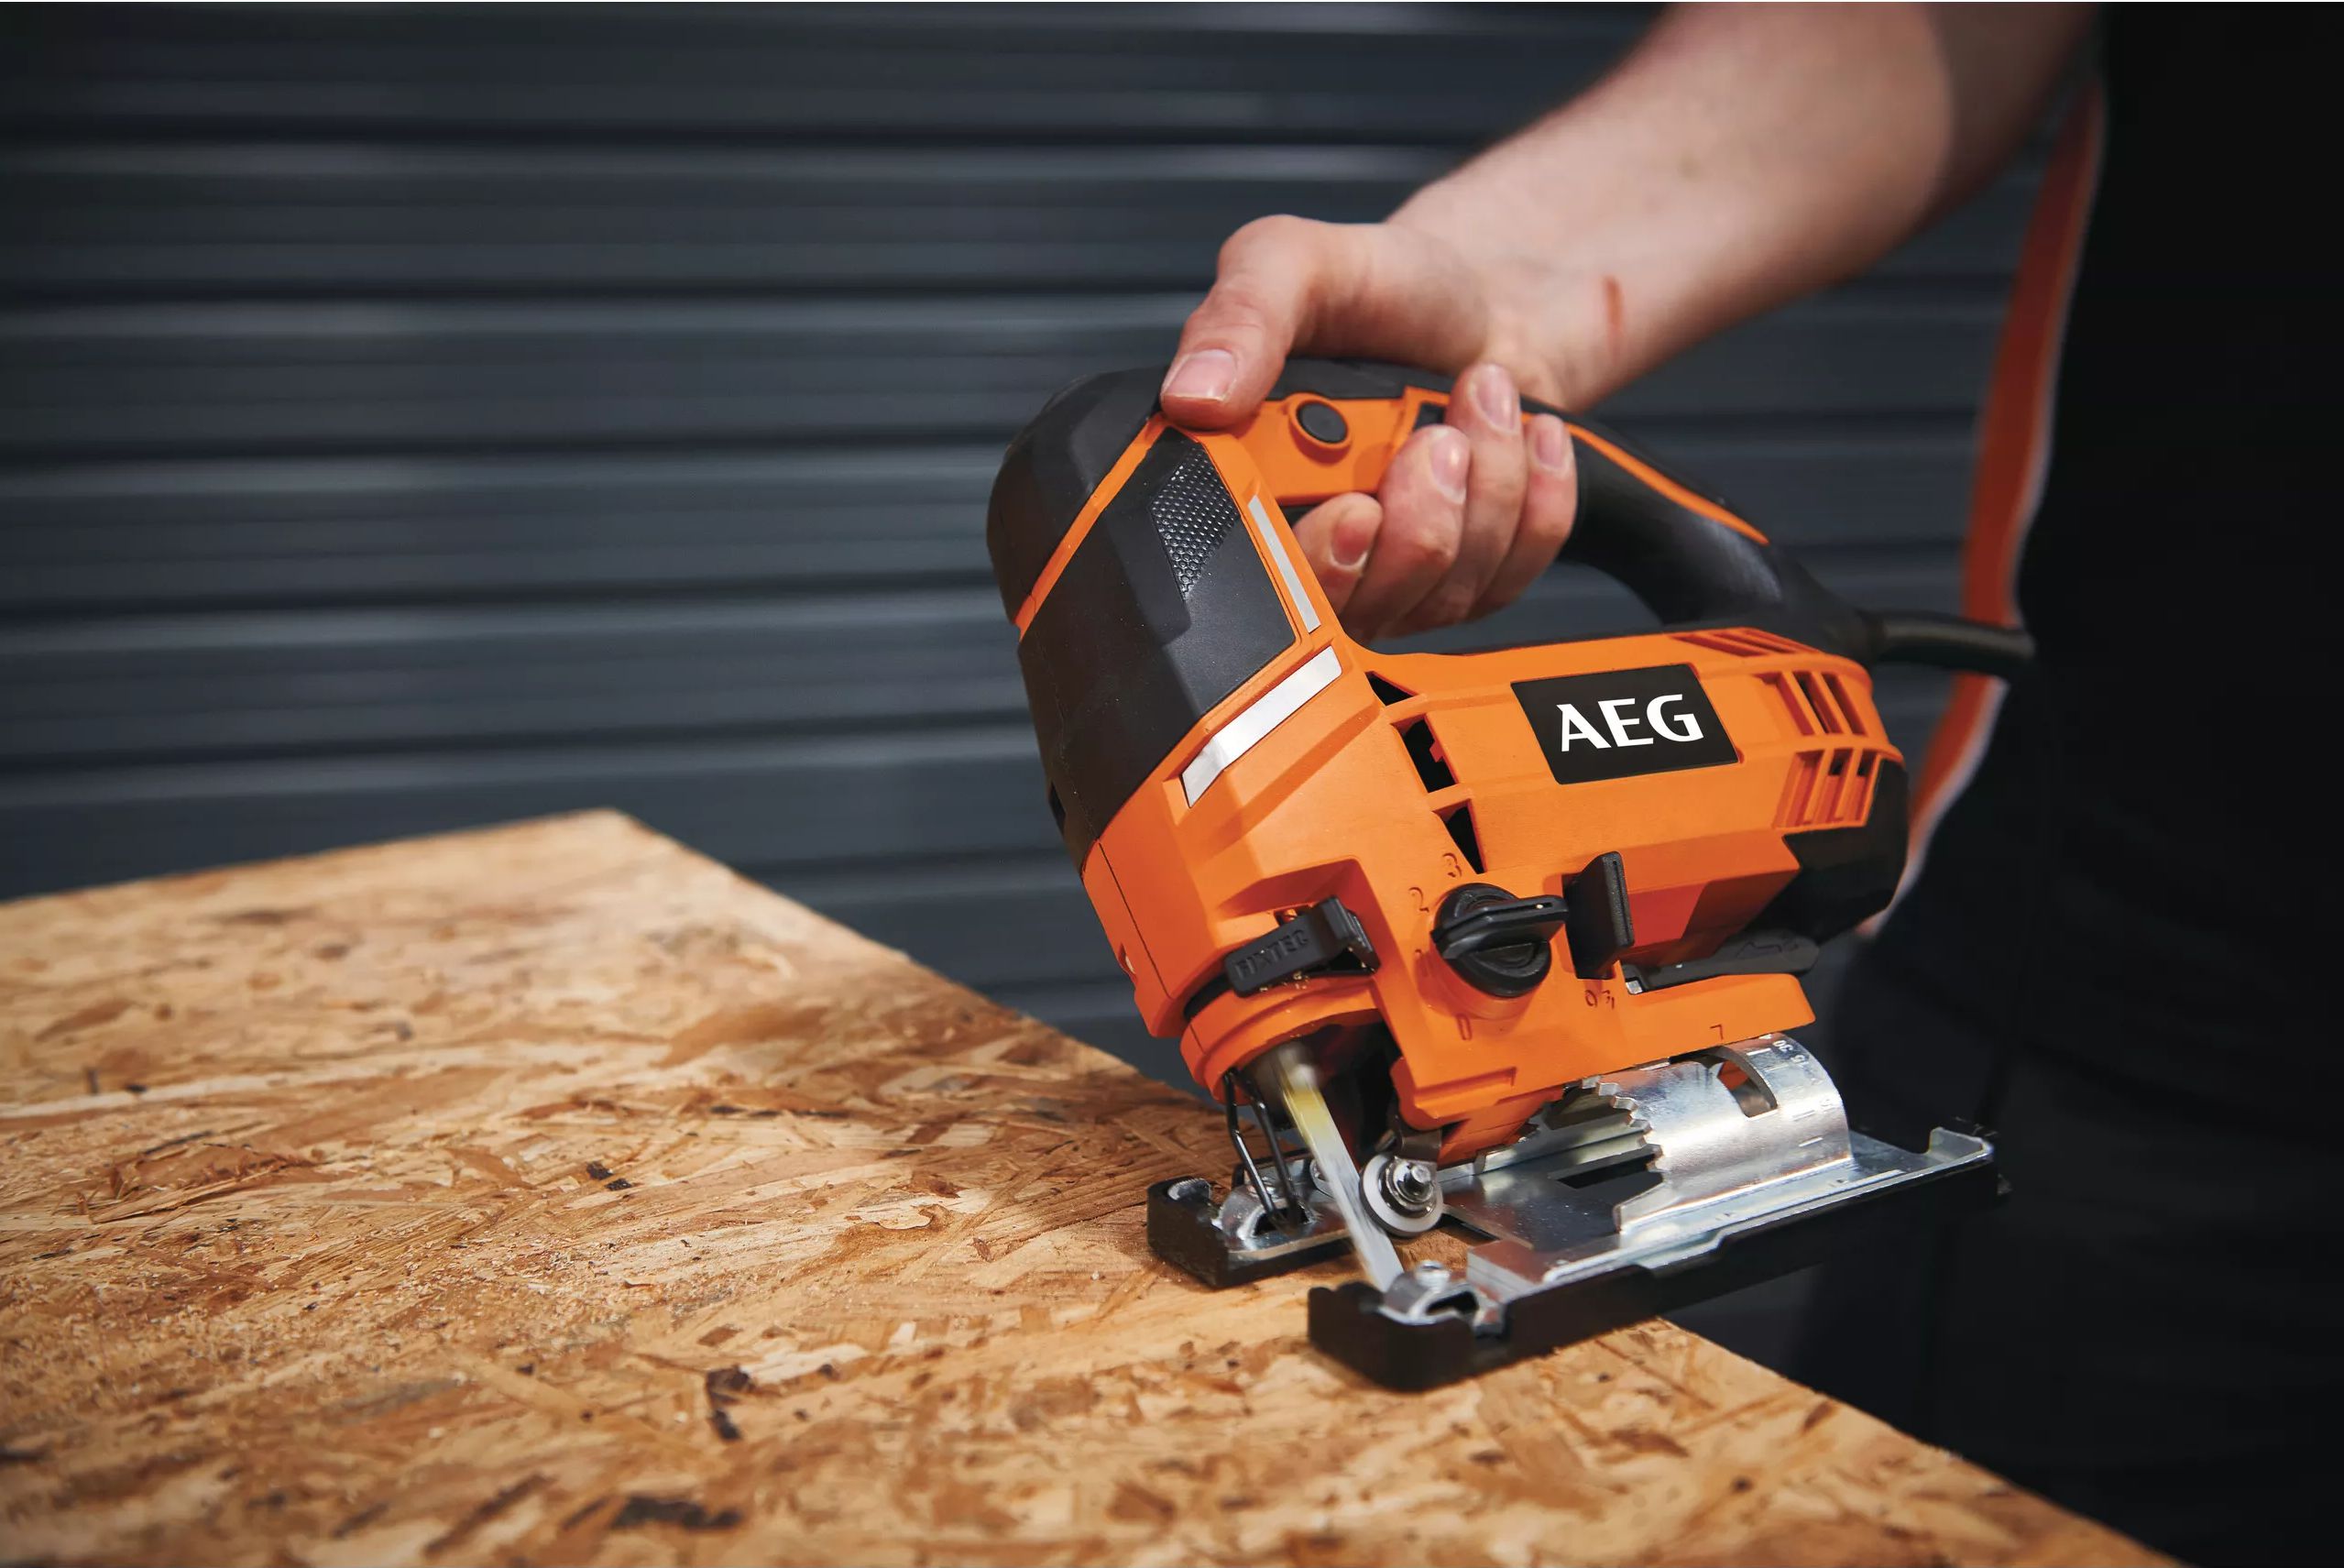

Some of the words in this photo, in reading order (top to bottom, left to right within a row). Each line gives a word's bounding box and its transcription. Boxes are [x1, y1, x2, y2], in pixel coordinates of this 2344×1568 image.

[1556, 694, 1704, 751] AEG
[1442, 852, 1462, 877] 3
[1408, 886, 1429, 913] 2
[1234, 928, 1309, 981] FIXTEC
